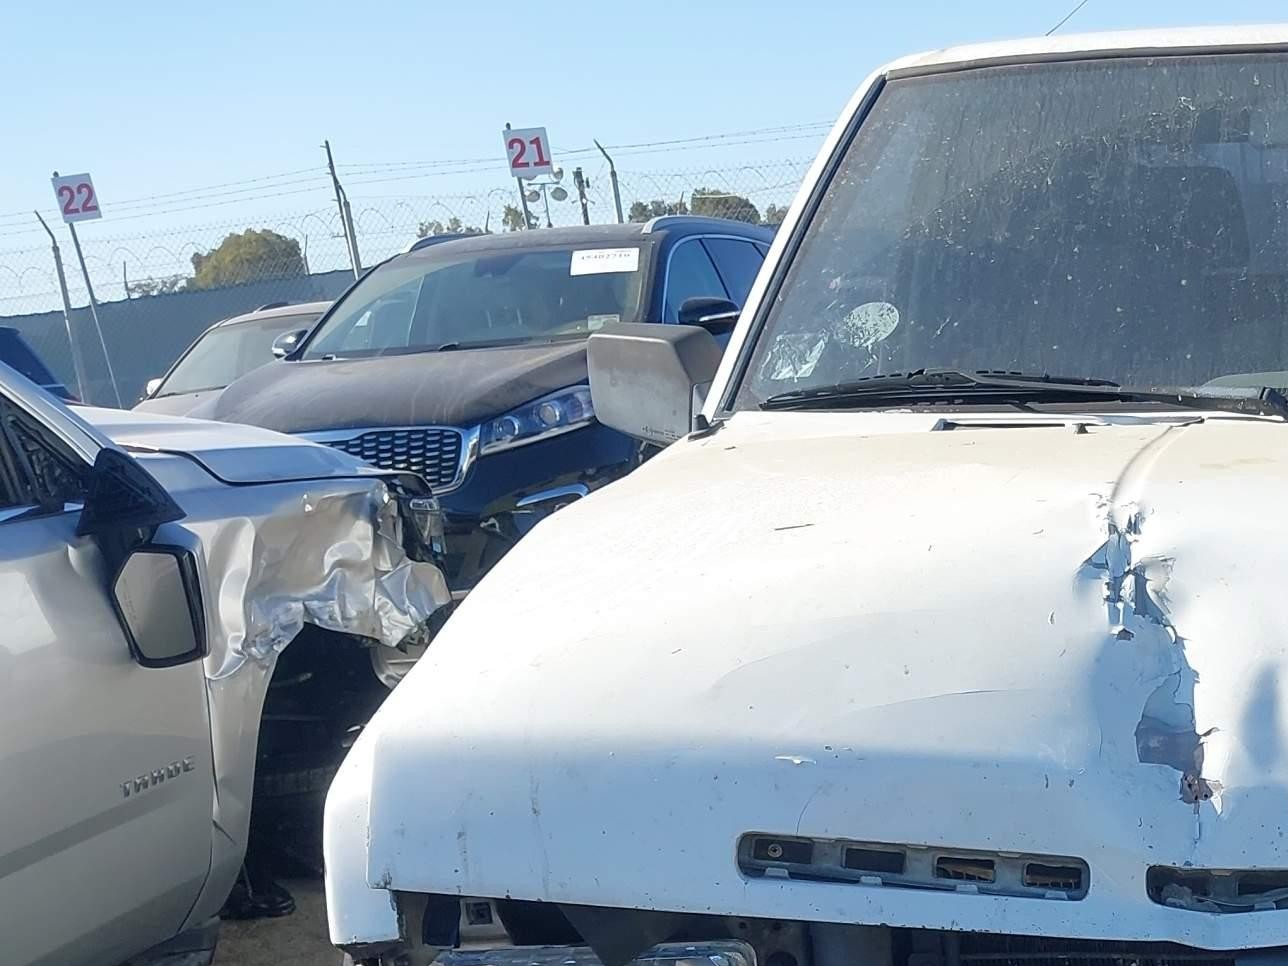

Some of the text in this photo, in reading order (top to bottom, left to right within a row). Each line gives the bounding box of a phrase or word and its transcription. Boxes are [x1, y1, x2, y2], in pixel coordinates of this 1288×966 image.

[508, 136, 550, 168] 21
[58, 183, 97, 215] 22
[120, 754, 195, 799] TAHOE
